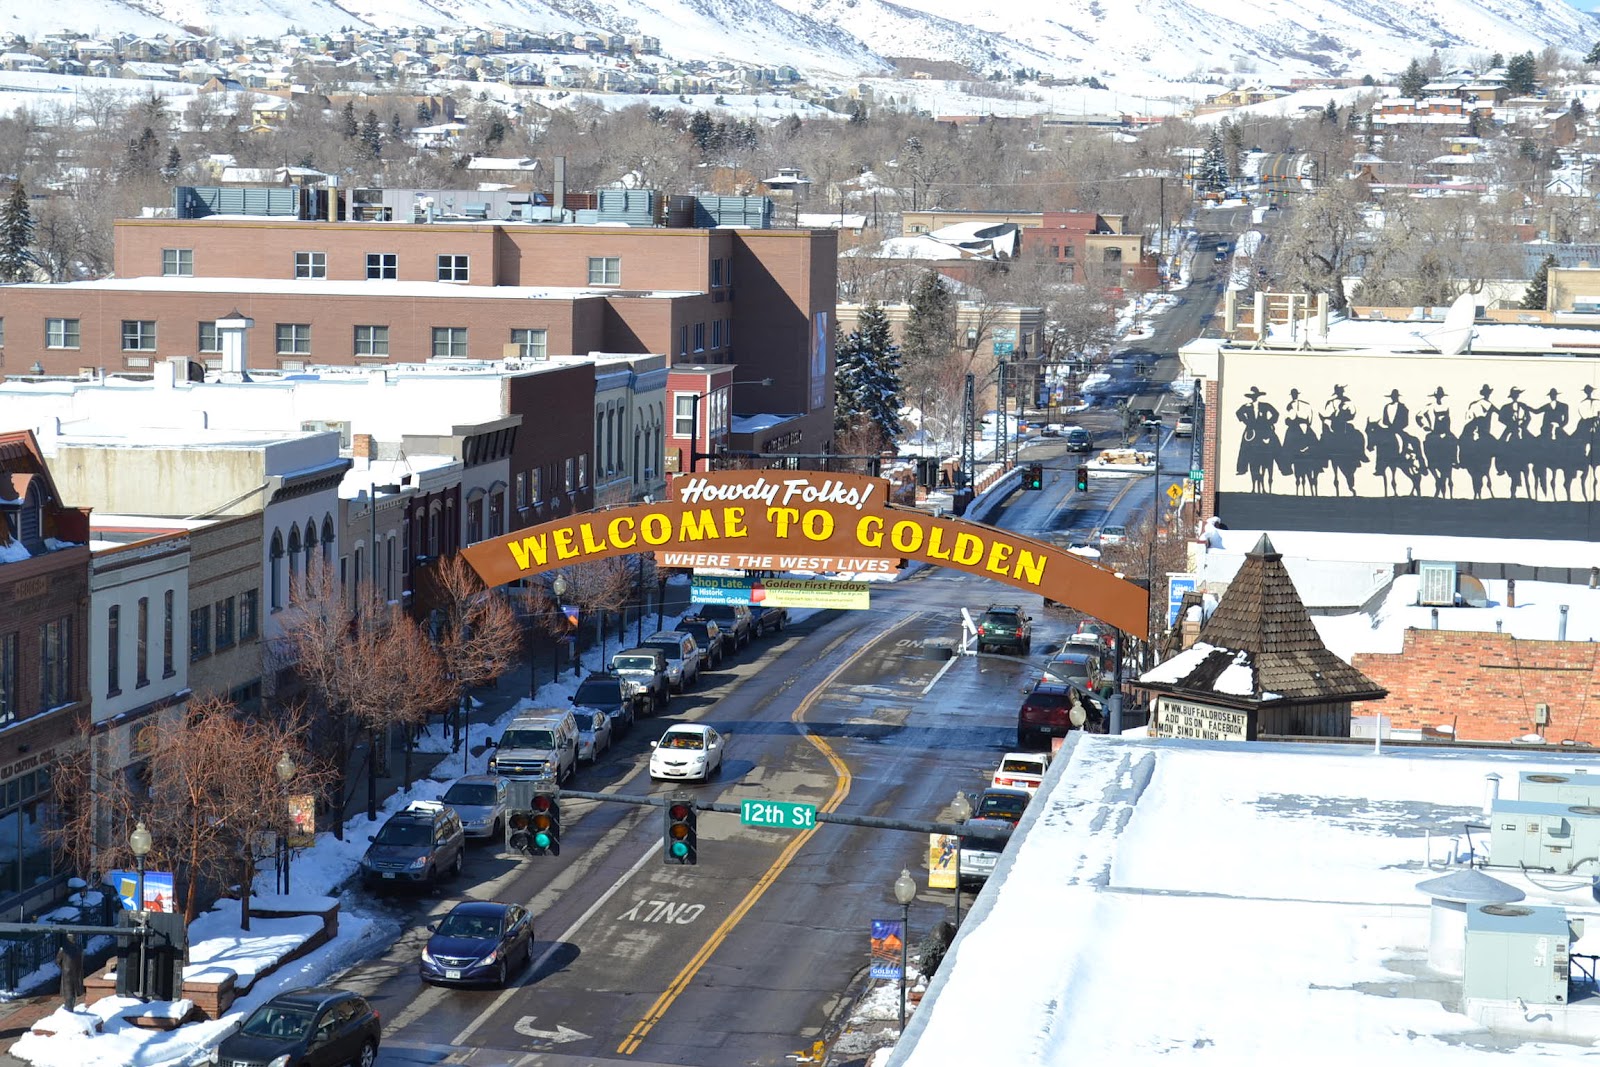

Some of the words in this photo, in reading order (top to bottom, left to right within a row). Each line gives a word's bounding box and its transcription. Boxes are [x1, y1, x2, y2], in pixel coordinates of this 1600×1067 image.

[681, 478, 780, 506] Howdy
[783, 479, 876, 511] Folks!
[507, 506, 748, 571] WELCOME
[766, 506, 835, 541] TO
[856, 515, 1048, 586] GOLDEN
[664, 553, 731, 567] WHERE
[736, 556, 773, 568] THE
[779, 556, 833, 570] WEST
[837, 559, 890, 572] LIVES
[692, 577, 719, 589] Shop
[765, 580, 802, 589] Golden
[804, 581, 827, 590] First
[828, 582, 867, 592] Fridays
[692, 596, 726, 604] Downtown
[726, 597, 750, 605] Golden
[699, 588, 724, 597] Historic
[1158, 722, 1174, 734] MON
[1165, 713, 1180, 724] ADD
[1208, 720, 1243, 736] FACEBOOK
[1, 765, 14, 780] OLD
[744, 802, 784, 824] 12th
[792, 806, 812, 827] St
[616, 899, 707, 925] ONLY
